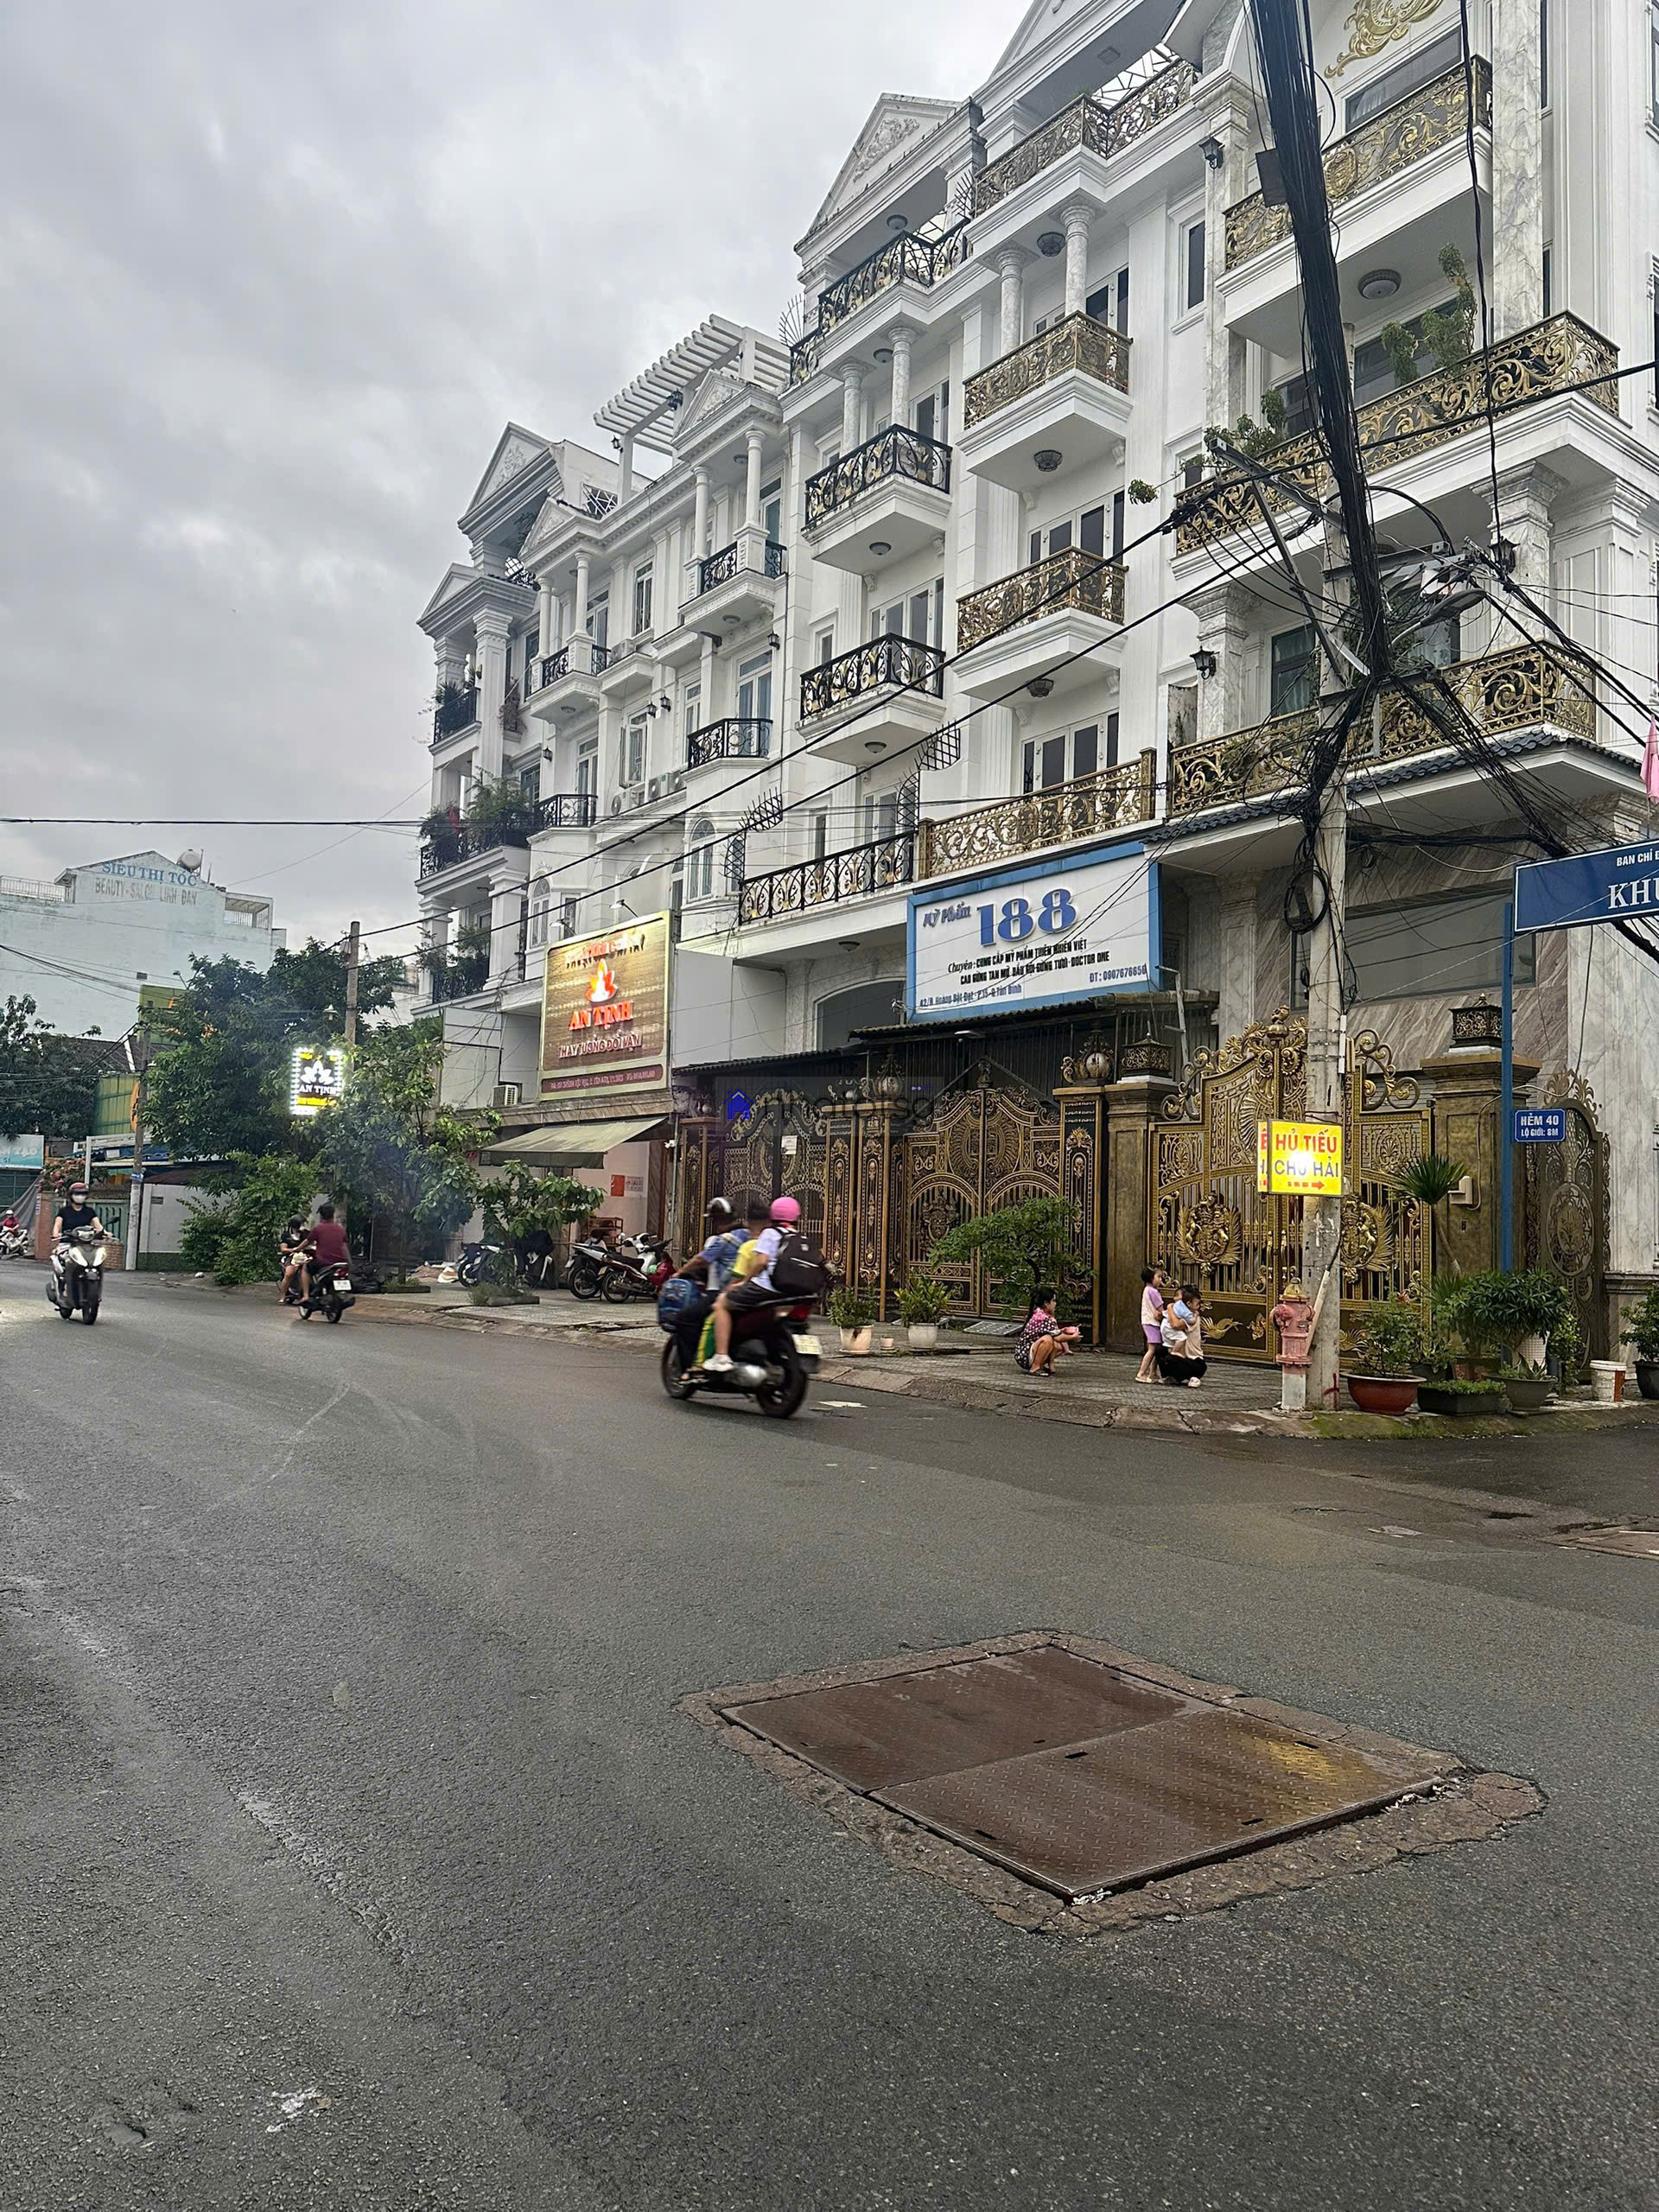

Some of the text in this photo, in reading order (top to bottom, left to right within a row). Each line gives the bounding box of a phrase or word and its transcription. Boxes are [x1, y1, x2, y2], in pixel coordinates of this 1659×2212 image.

[1616, 855, 1636, 867] BAN
[1637, 849, 1653, 863] CHỈ
[138, 867, 165, 885] THỊ
[168, 871, 197, 887] TÓC
[976, 888, 1077, 948] 188
[1073, 938, 1087, 952] VIỆT
[1096, 950, 1109, 963] ONE
[569, 1001, 634, 1031] AN TỊNH
[299, 1084, 313, 1093] AN
[1521, 1113, 1559, 1126] HẺM 40
[1275, 1128, 1298, 1151] HỦ
[1303, 1128, 1338, 1154] TIẾU
[1547, 1128, 1559, 1136] 8M
[1313, 1155, 1339, 1178] HẢI
